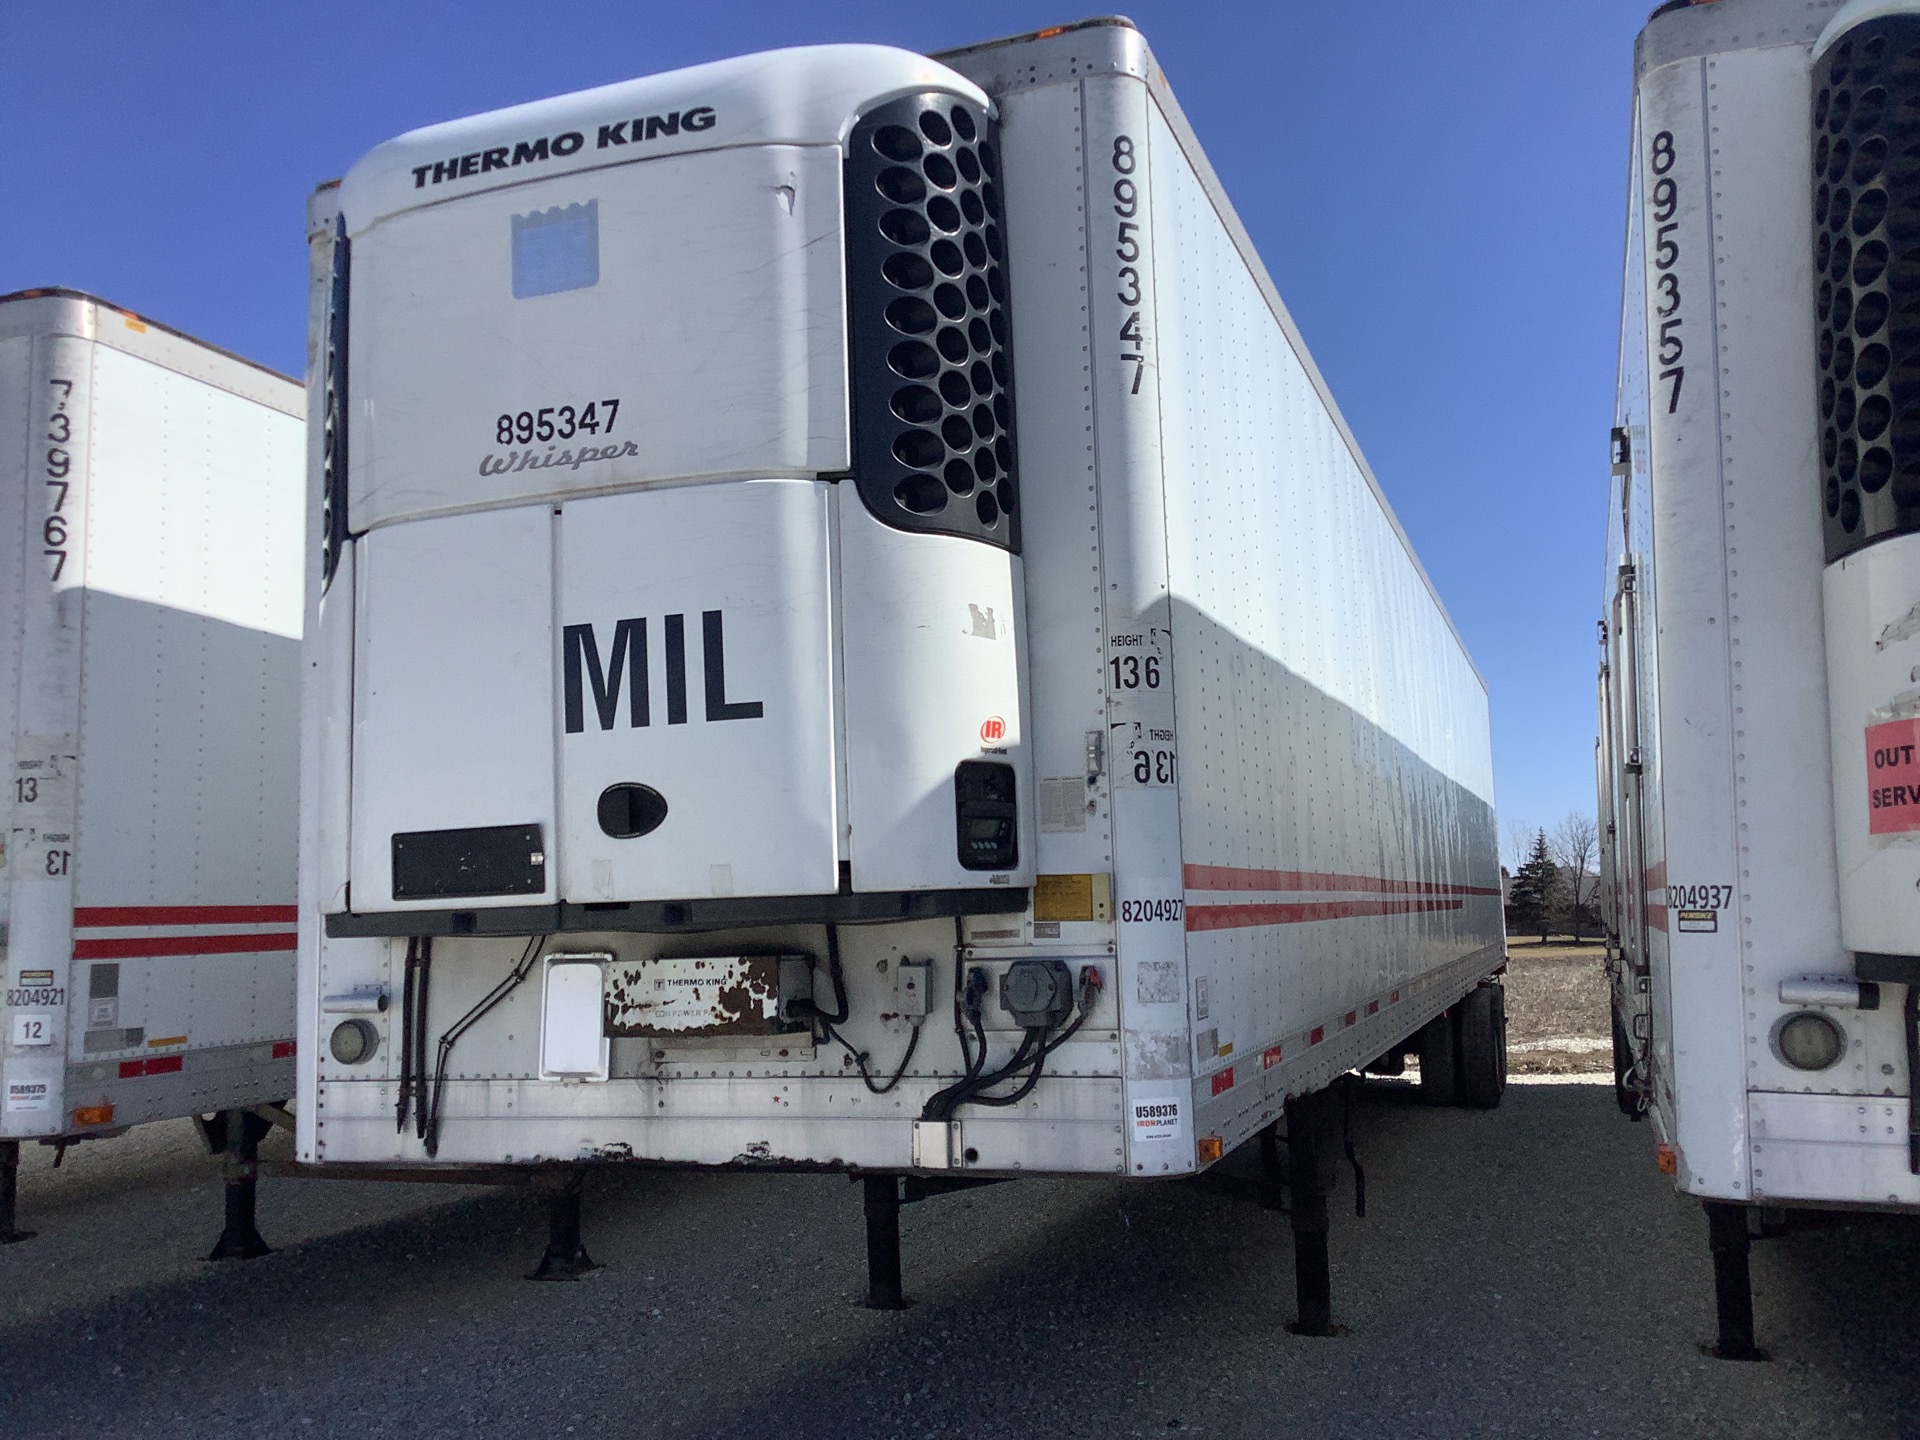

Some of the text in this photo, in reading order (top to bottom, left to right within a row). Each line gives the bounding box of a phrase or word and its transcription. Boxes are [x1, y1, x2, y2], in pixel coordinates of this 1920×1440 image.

[411, 106, 717, 189] THERMO KING
[1112, 135, 1145, 395] 895347
[1652, 130, 1685, 414] 895357
[496, 399, 620, 445] 895347
[479, 441, 639, 477] Whisper
[1110, 634, 1144, 647] HEIGHT
[562, 609, 764, 734] MIL
[984, 720, 1002, 739] IR
[1874, 744, 1915, 769] OUT
[1668, 884, 1733, 910] 8204937
[1122, 899, 1183, 923] 8204927
[667, 978, 704, 987] THERMO
[706, 978, 728, 986] KING
[6, 988, 65, 1007] 8204921
[22, 1021, 43, 1039] 12
[1135, 1103, 1178, 1119] U589376
